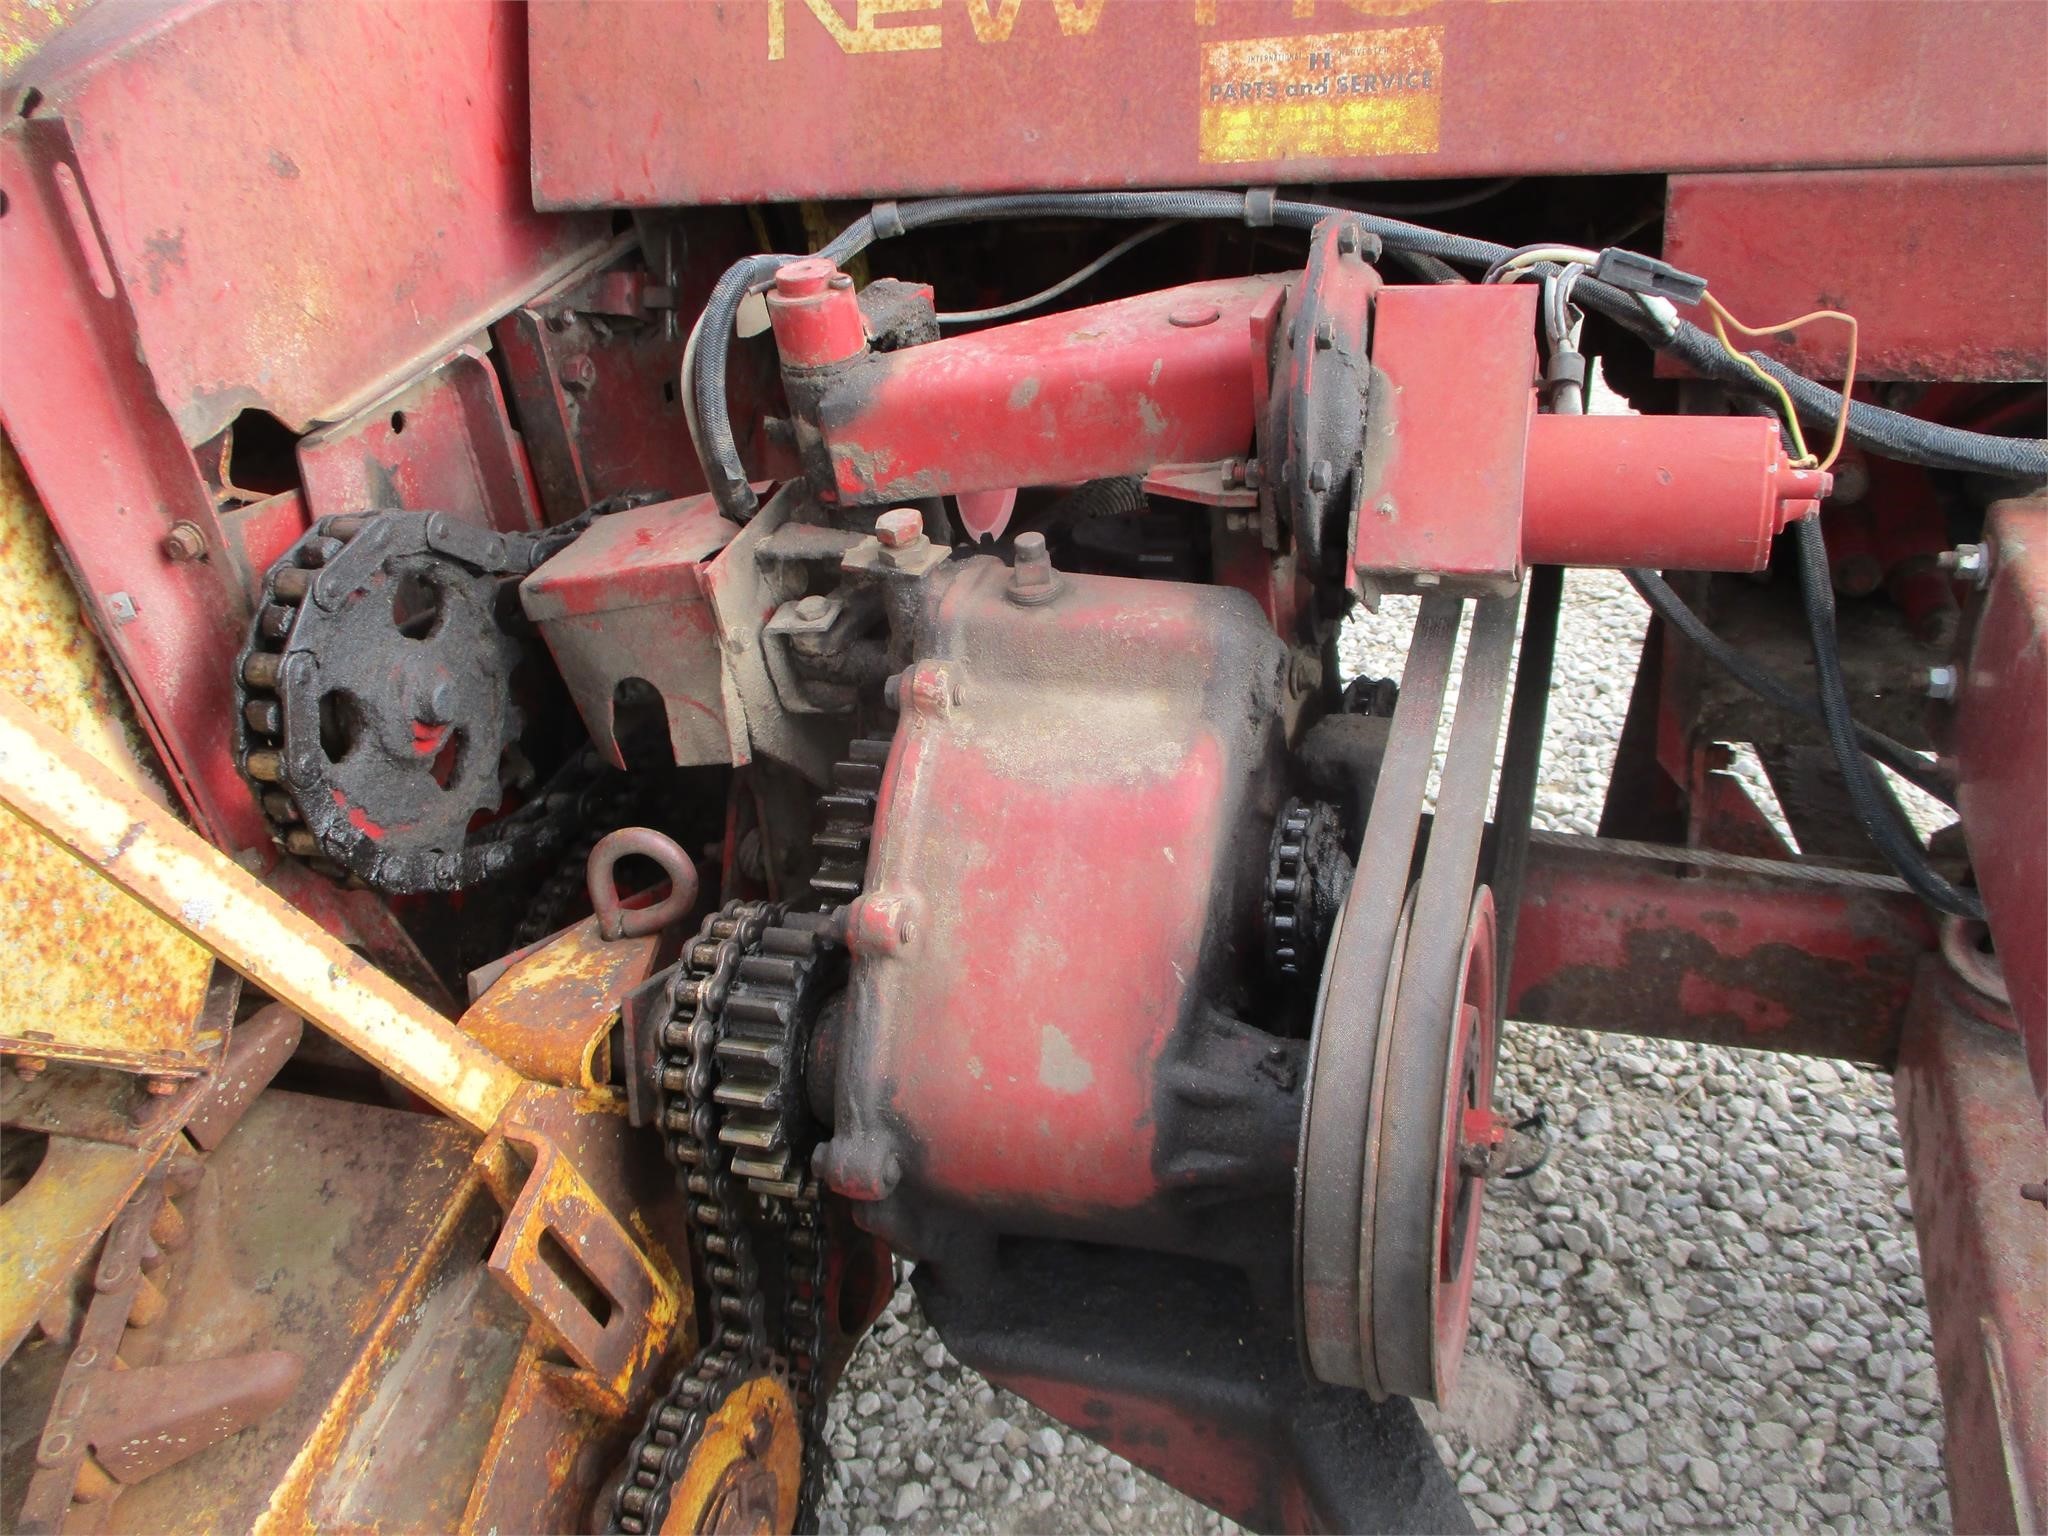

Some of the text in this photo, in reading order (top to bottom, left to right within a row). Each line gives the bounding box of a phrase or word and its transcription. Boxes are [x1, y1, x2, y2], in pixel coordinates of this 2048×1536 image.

[1209, 69, 1433, 101] PARTS and SERVICE
